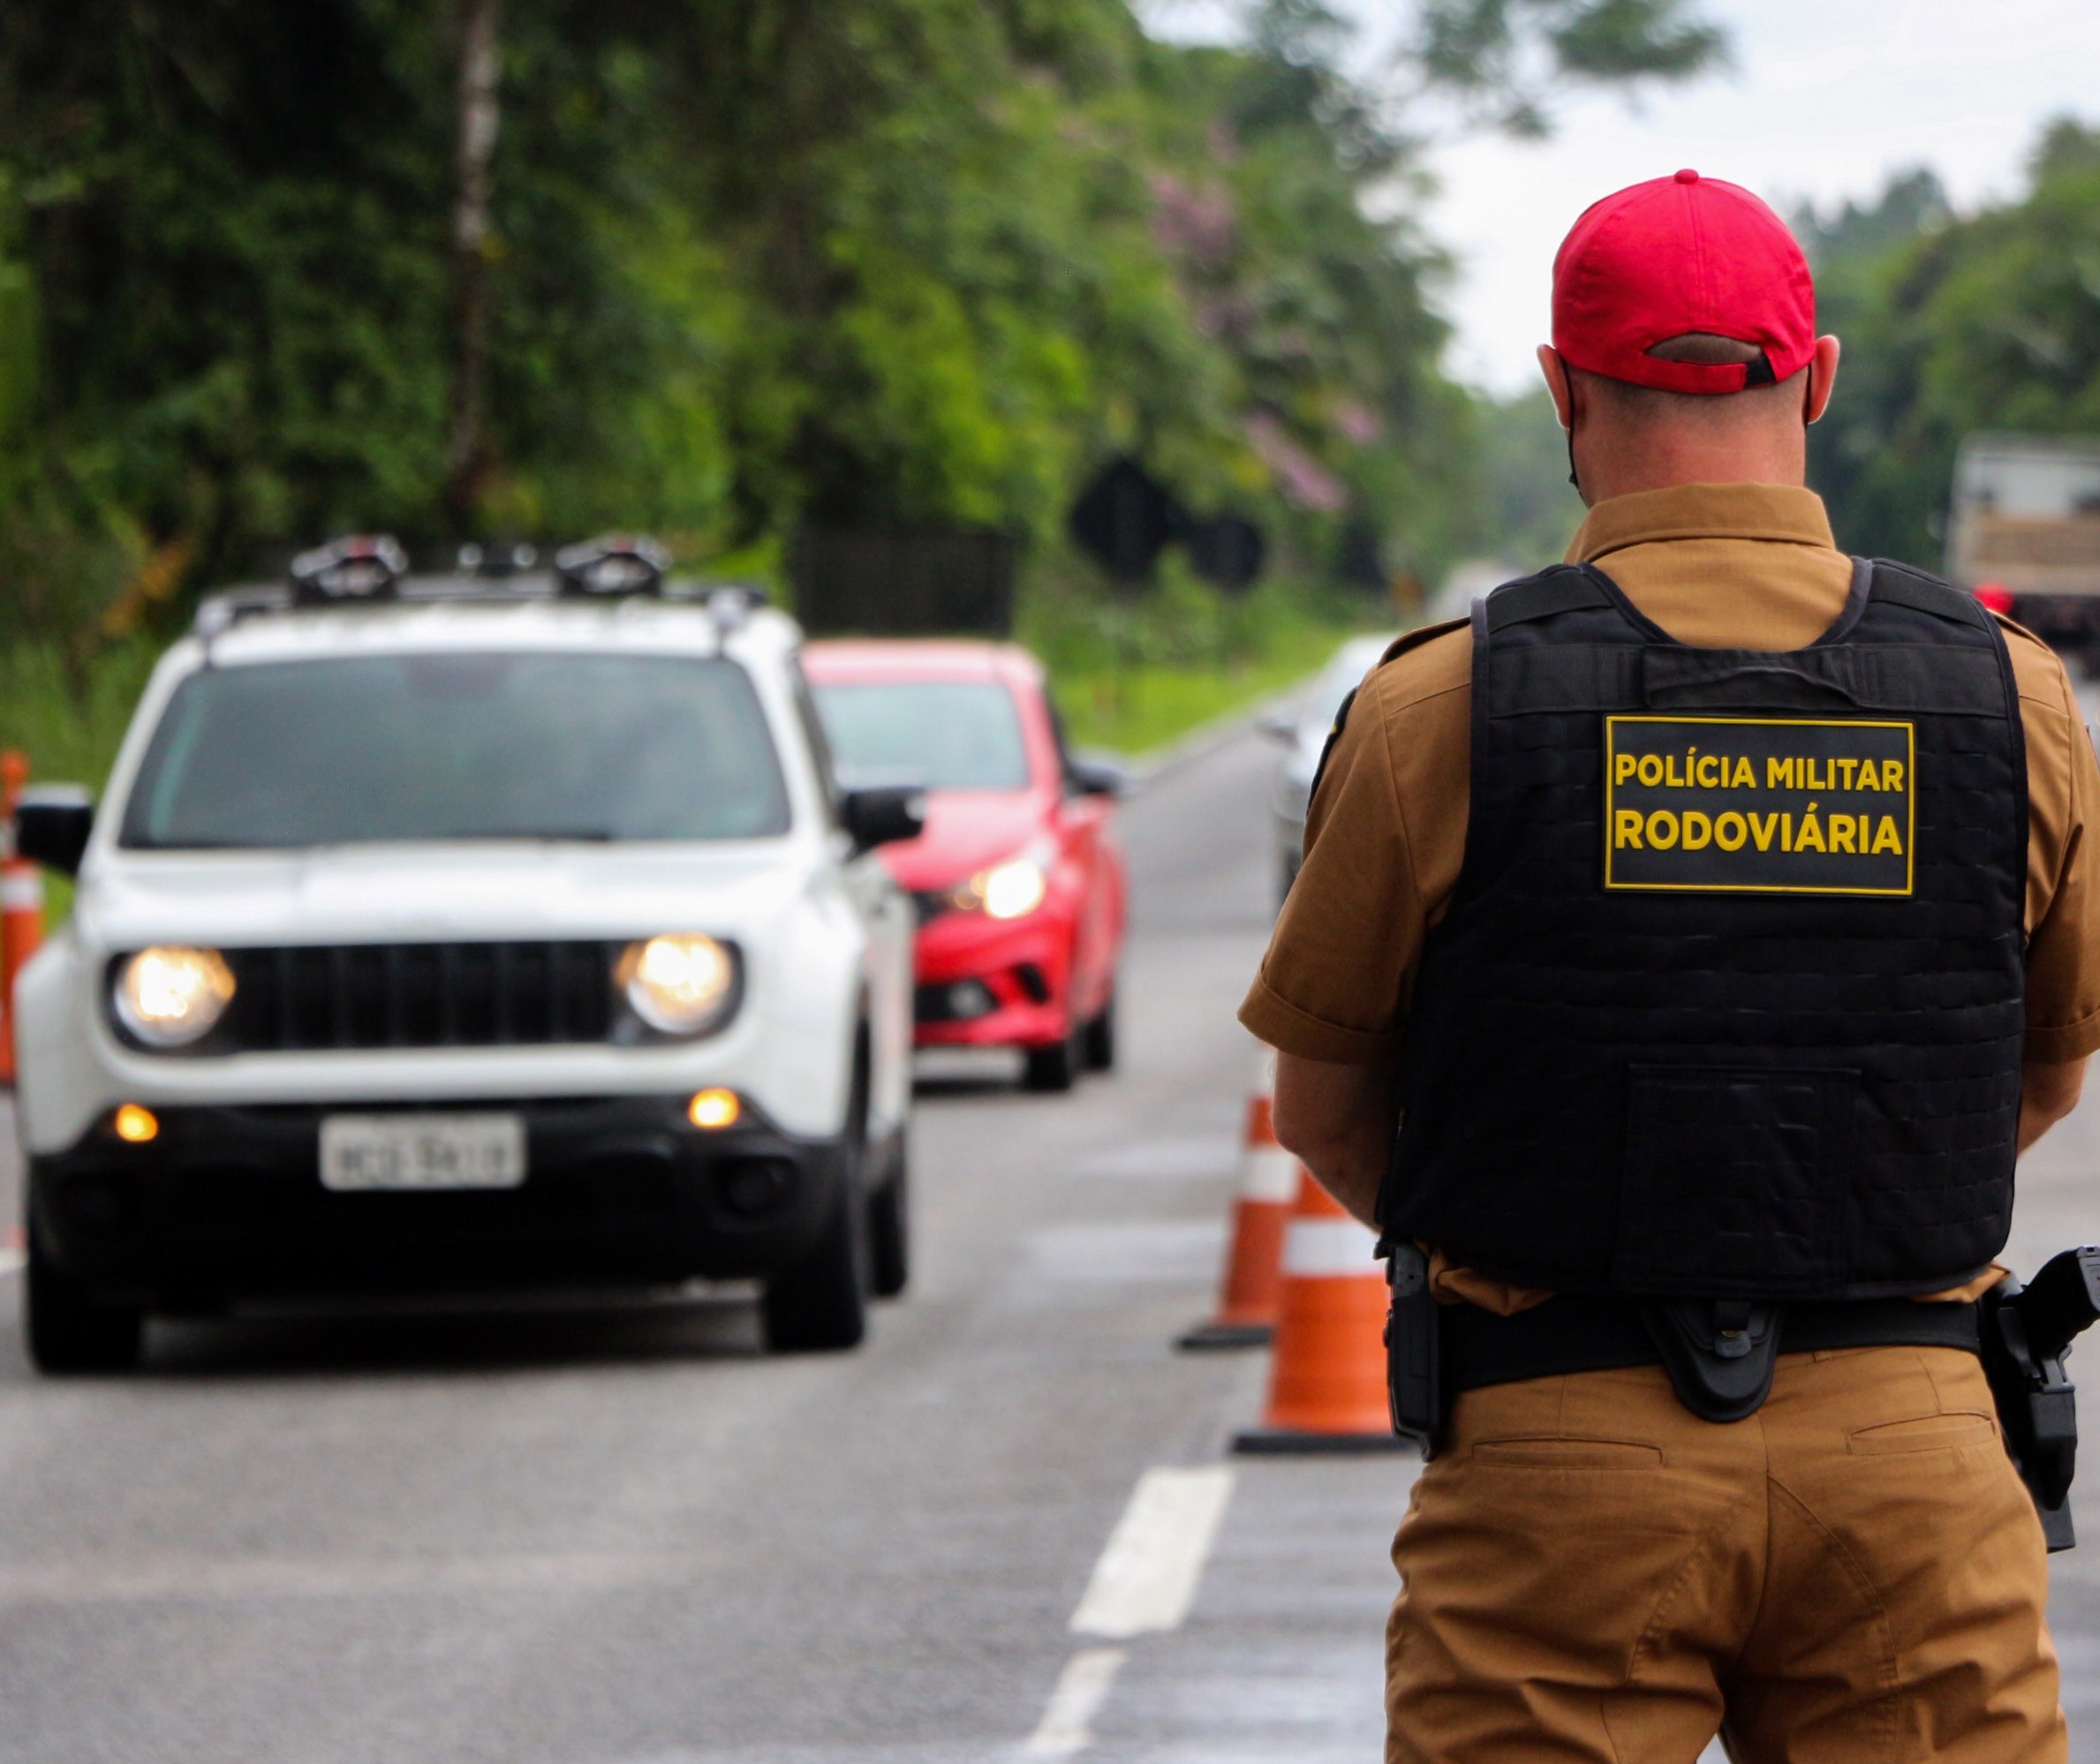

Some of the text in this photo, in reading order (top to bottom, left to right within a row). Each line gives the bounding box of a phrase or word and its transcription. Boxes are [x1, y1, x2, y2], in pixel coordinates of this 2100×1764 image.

[1615, 747, 1904, 792] POLÍCIA MILITAR
[1615, 802, 1903, 856] RODOVIÁRIA
